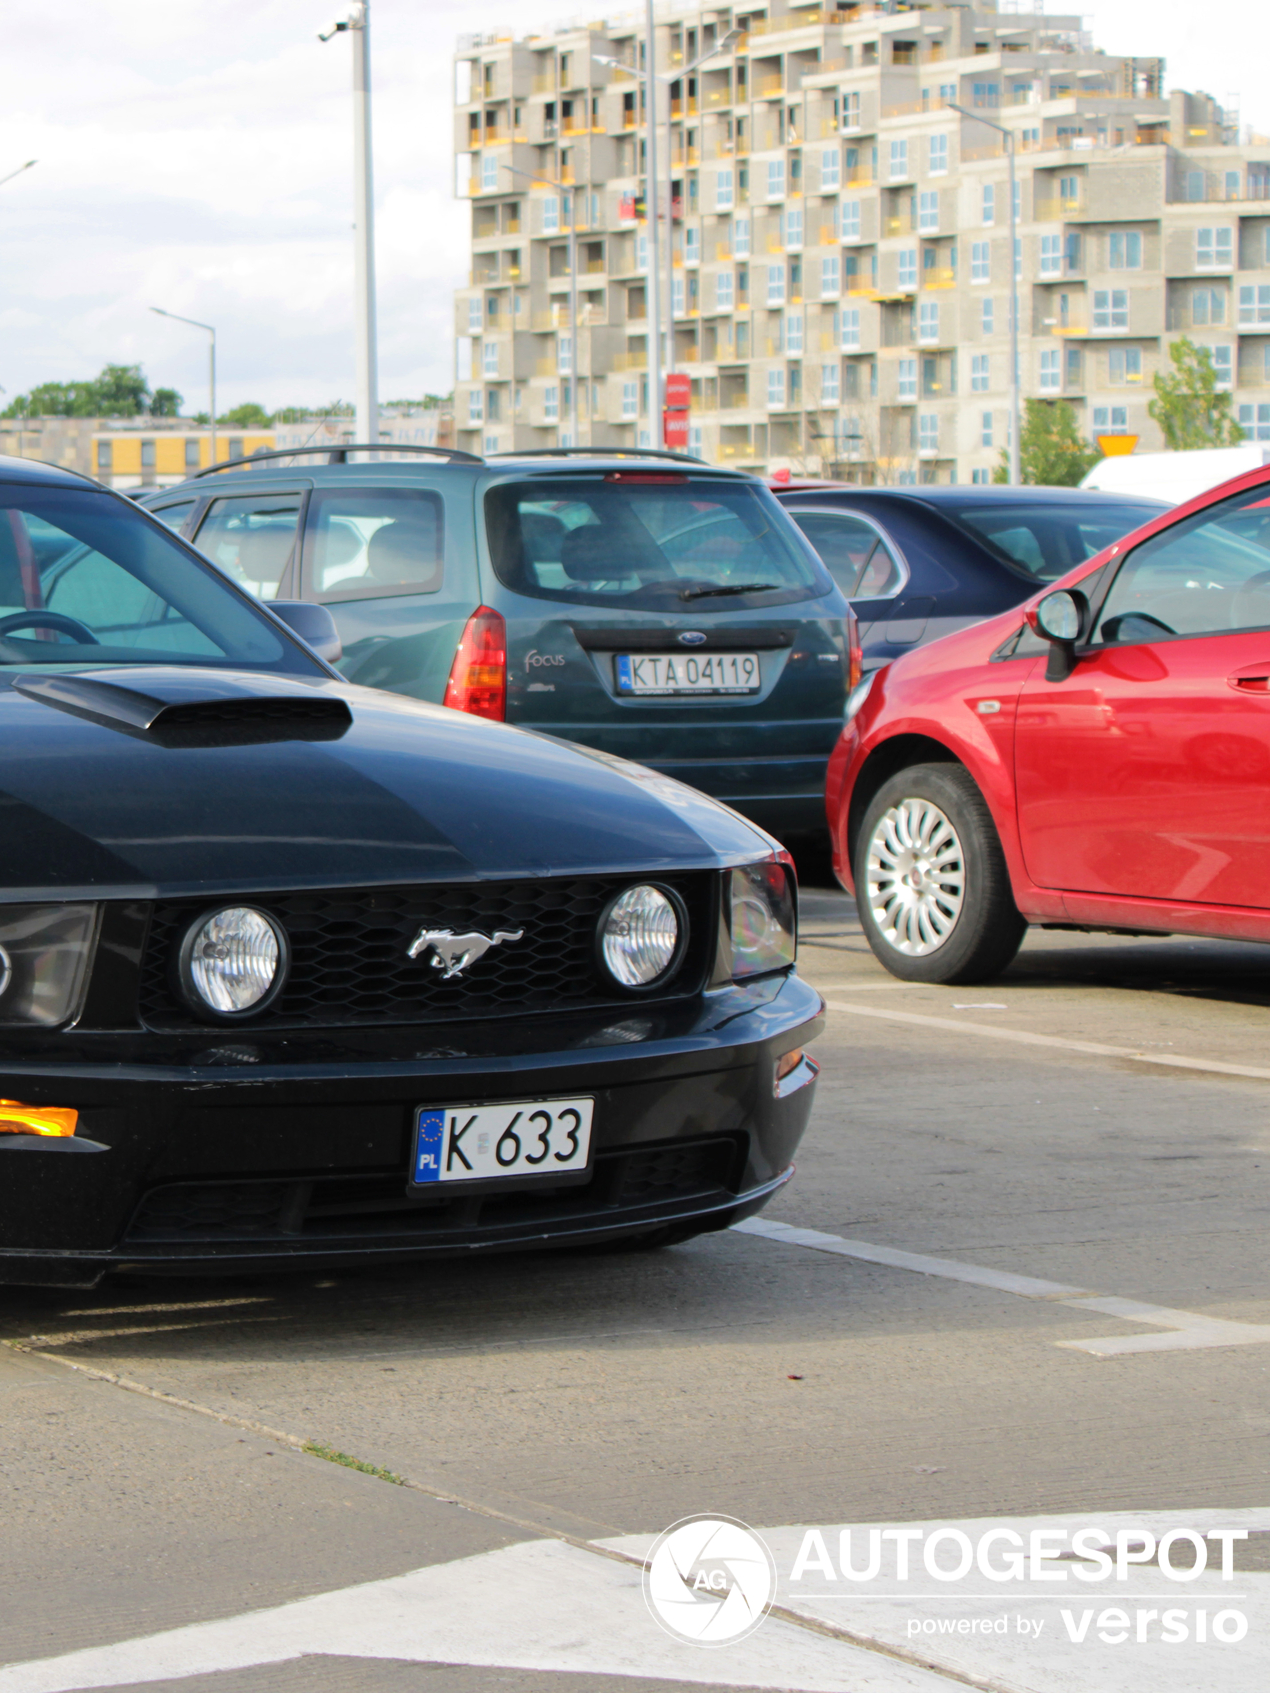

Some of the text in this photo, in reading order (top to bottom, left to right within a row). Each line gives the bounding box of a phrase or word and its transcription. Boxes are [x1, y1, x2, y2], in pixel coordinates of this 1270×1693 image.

[621, 676, 631, 685] PL
[632, 657, 755, 686] KTA 04119
[446, 1108, 582, 1172] K 633
[419, 1154, 438, 1170] PL
